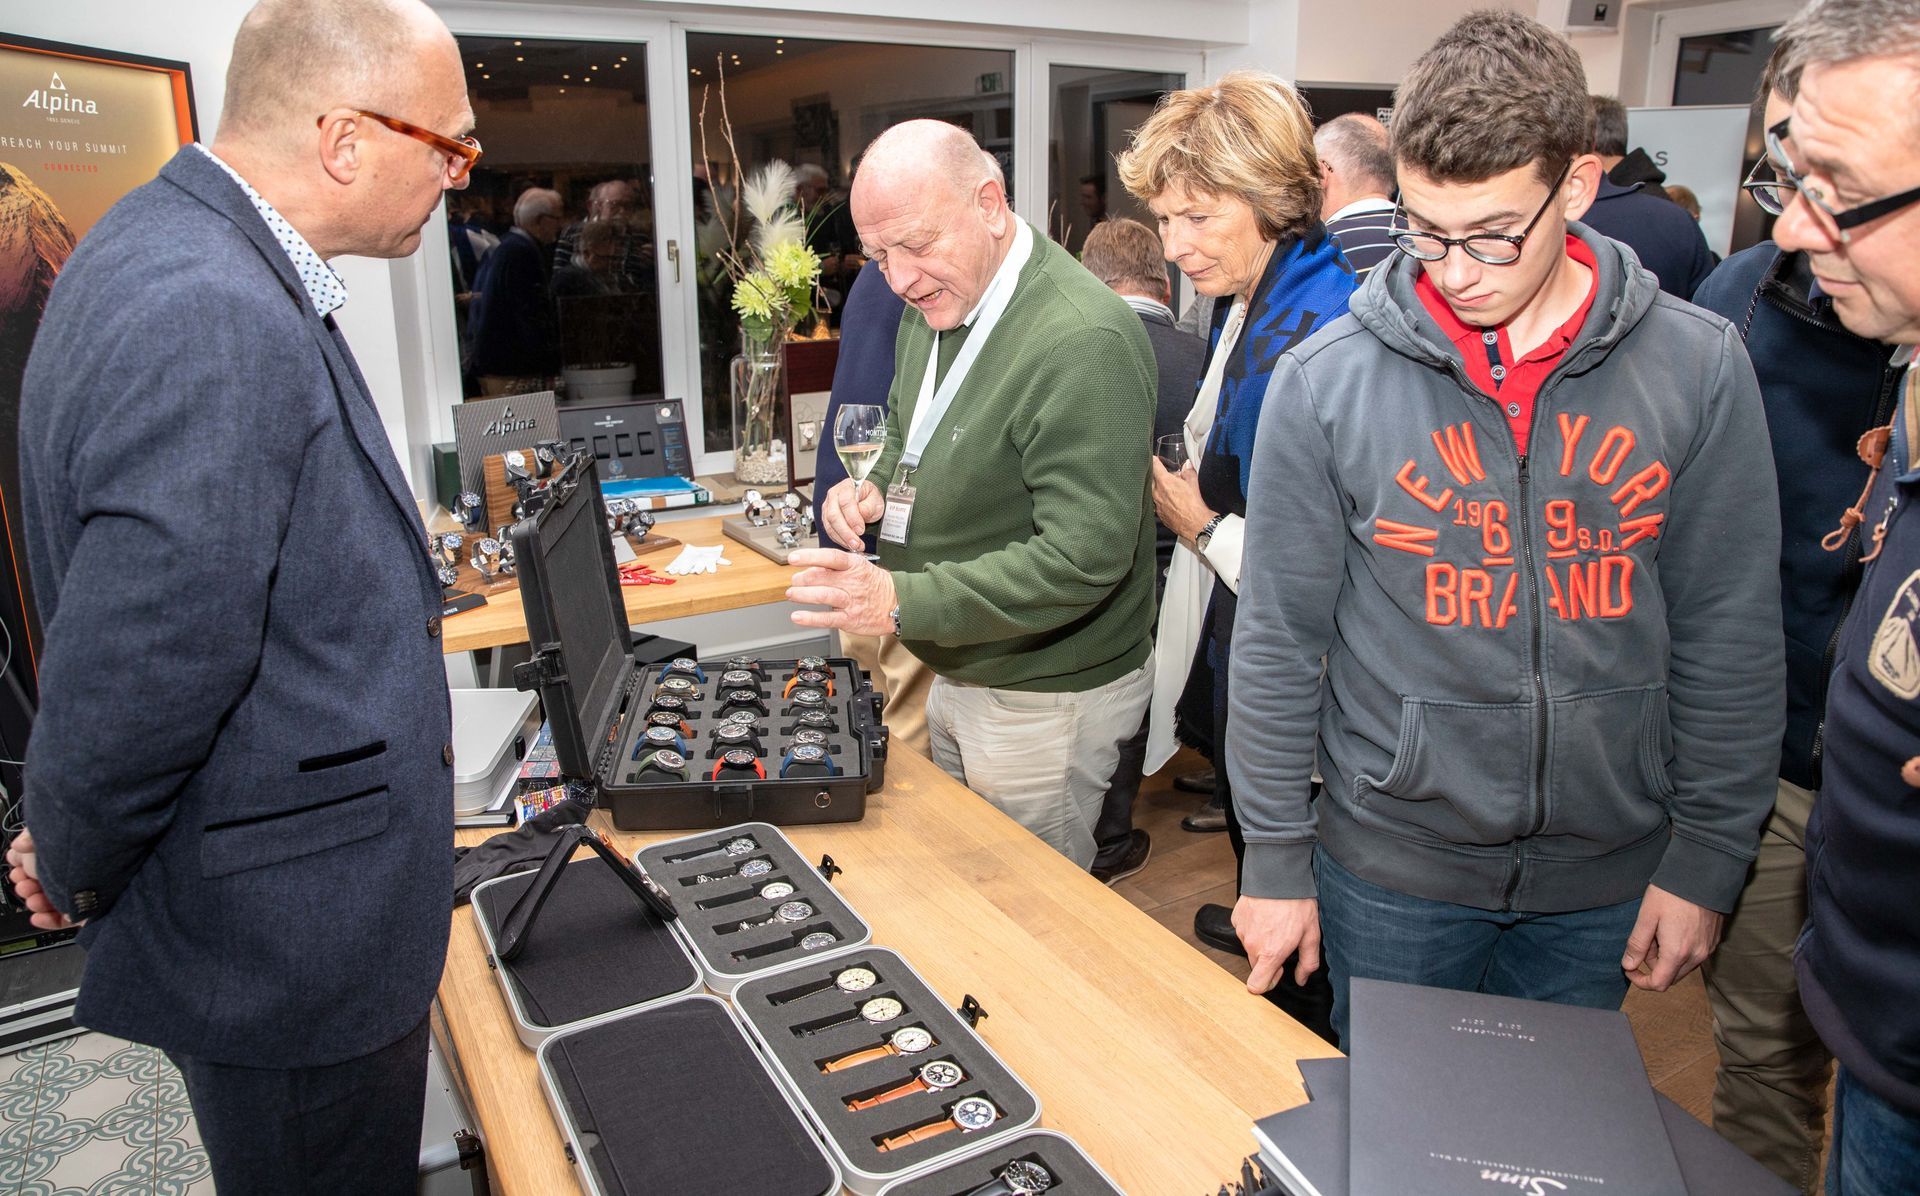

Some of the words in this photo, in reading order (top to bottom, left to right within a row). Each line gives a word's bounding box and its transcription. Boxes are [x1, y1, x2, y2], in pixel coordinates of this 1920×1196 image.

[22, 89, 99, 115] Alpina
[0, 136, 42, 150] REACH
[48, 140, 79, 152] YOUR
[85, 142, 128, 155] SUMMIT
[483, 418, 536, 438] Alpina
[1373, 421, 1487, 558] NEW
[1556, 412, 1671, 551] YORK
